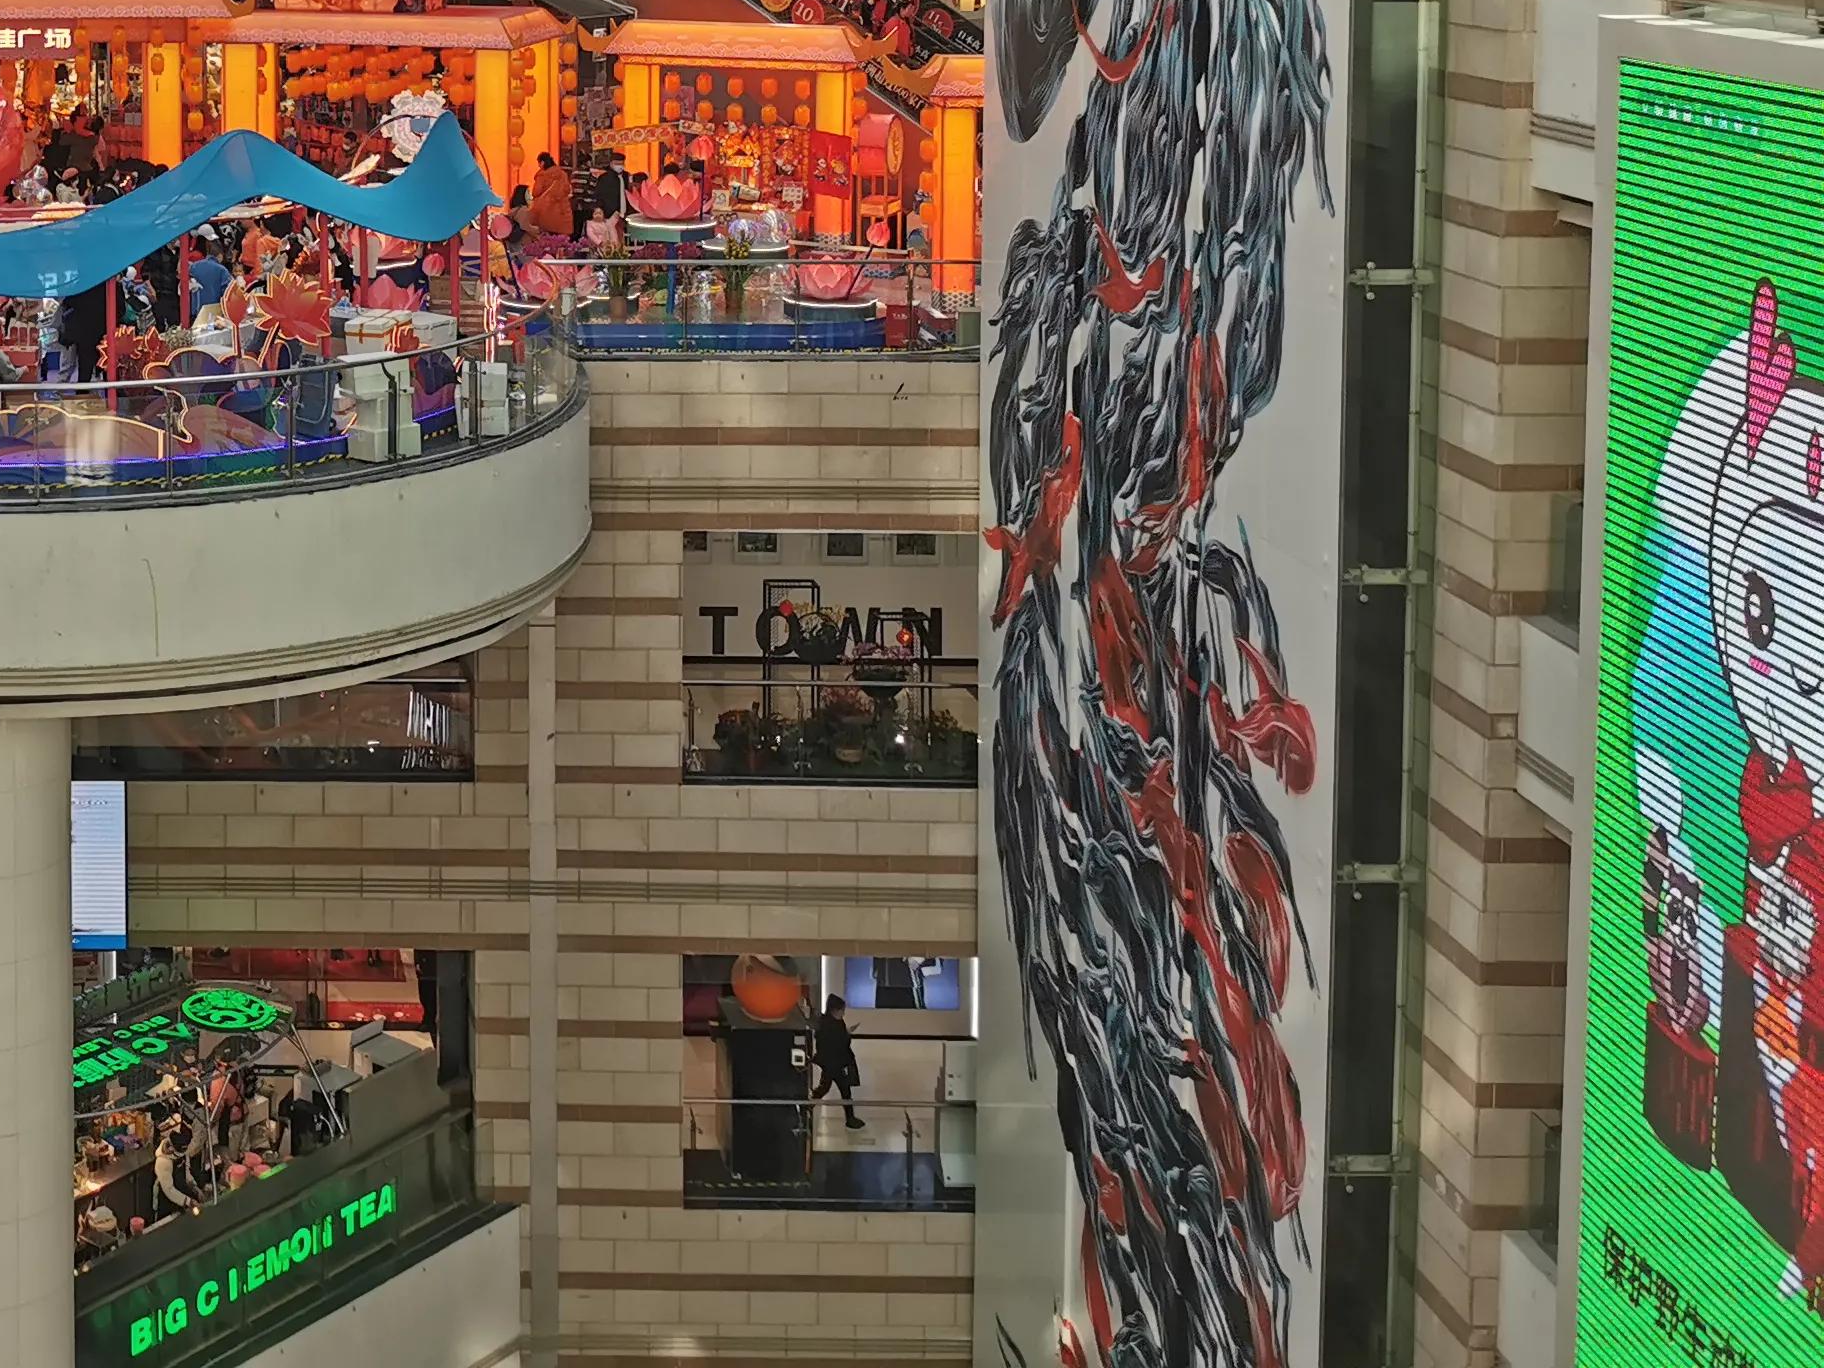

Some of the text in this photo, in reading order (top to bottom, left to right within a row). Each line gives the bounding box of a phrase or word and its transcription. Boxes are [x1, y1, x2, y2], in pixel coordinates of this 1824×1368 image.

[795, 4, 814, 22] 10
[699, 607, 942, 656] TOWN
[130, 1183, 393, 1357] BIG C LEMON TEA
